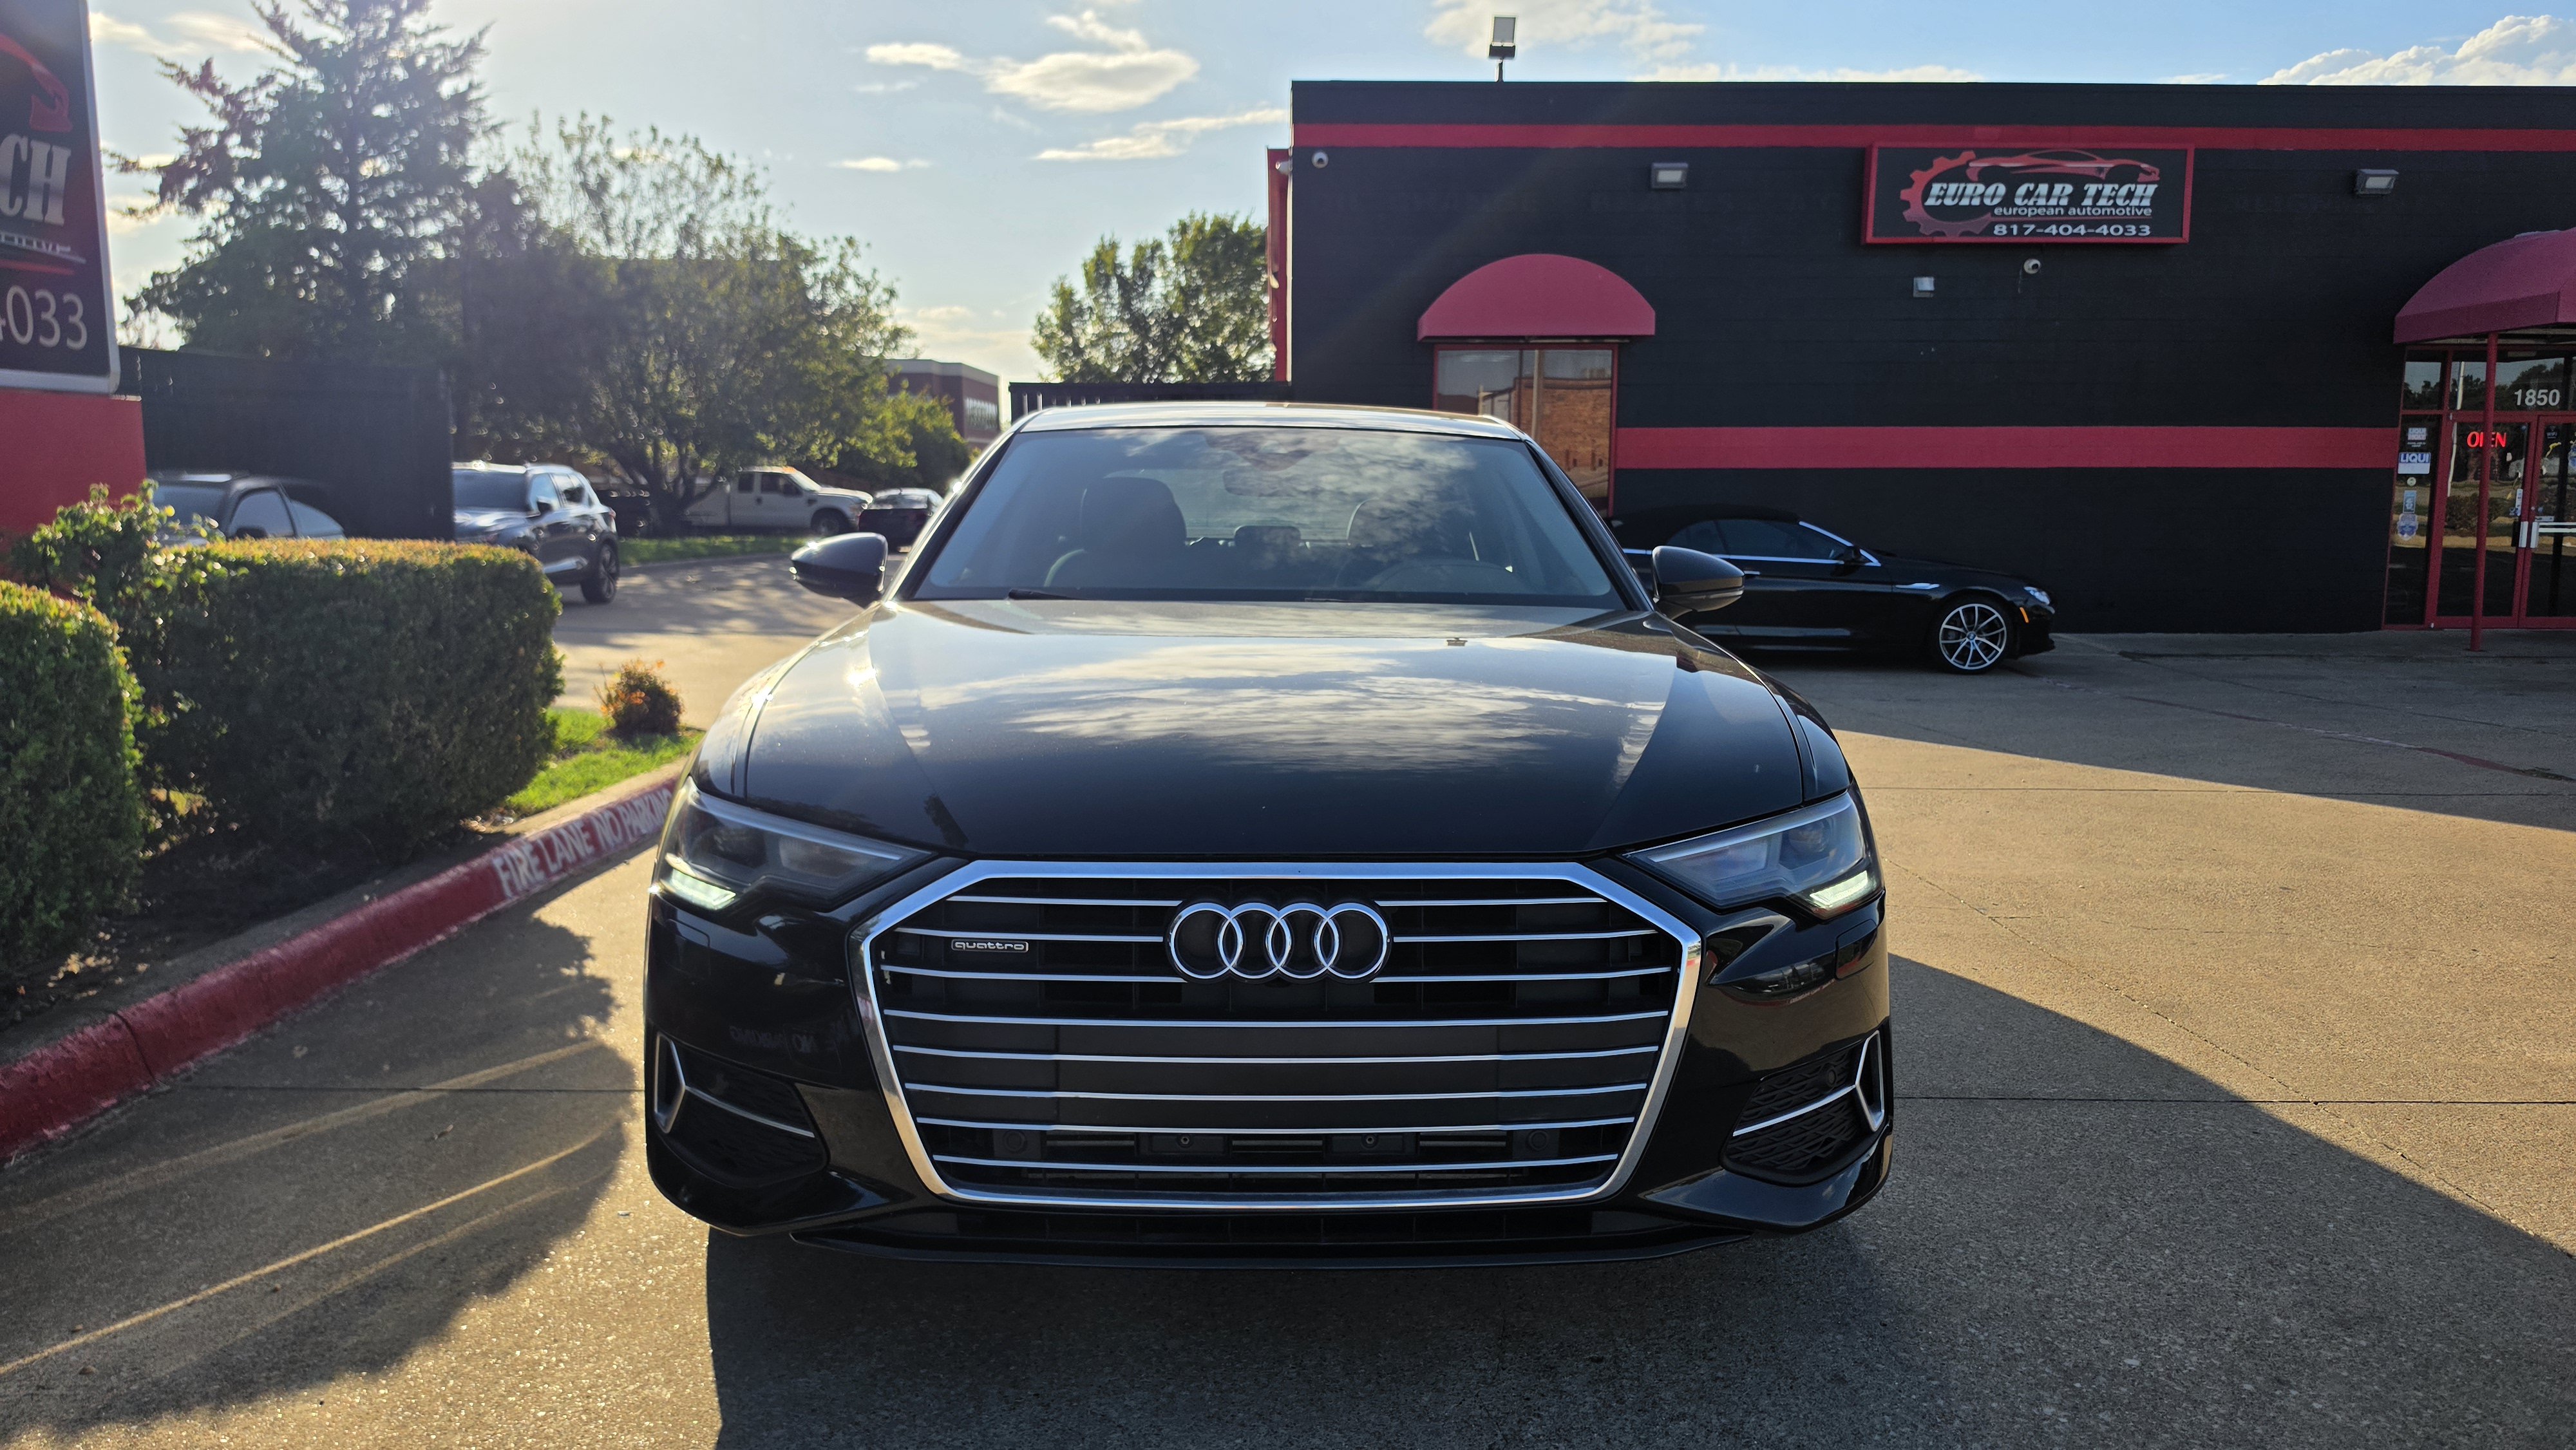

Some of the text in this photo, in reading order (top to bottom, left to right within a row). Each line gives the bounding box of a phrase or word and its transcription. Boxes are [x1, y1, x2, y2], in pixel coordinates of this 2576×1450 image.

[1924, 183, 2159, 206] EURO CAR TECH
[1994, 205, 2152, 217] european automotive
[1993, 224, 2151, 236] 817-404-4033
[2514, 389, 2560, 406] 1850
[2400, 453, 2430, 463] LIQUI
[493, 844, 545, 898] FIRE
[536, 819, 596, 874] LANE
[589, 809, 623, 849] NO
[954, 941, 1025, 950] quattro
